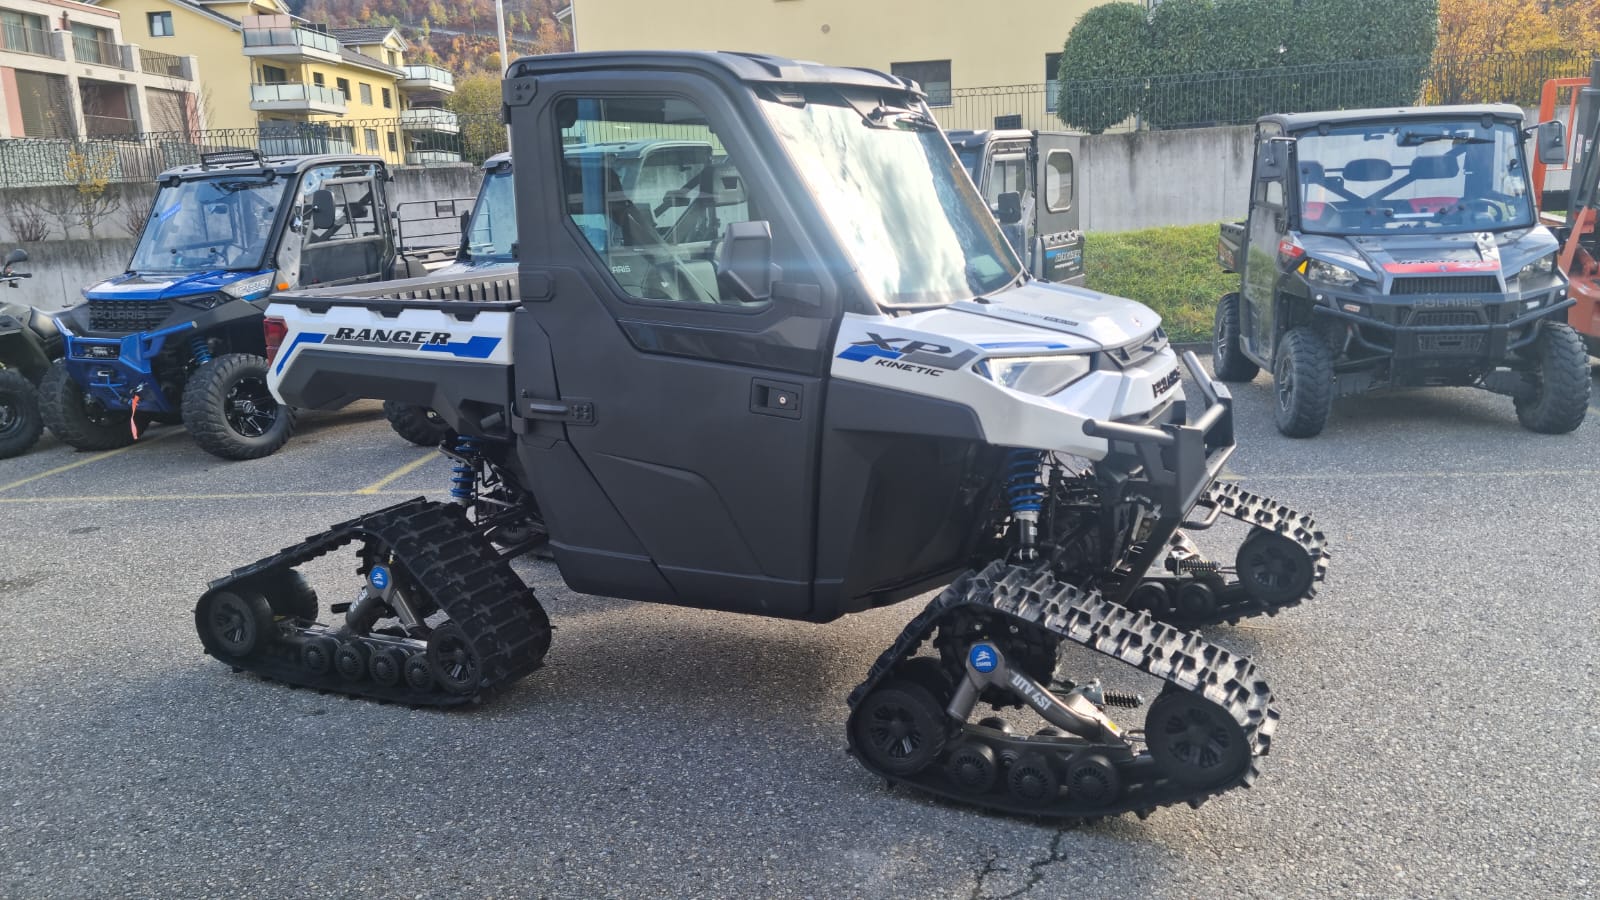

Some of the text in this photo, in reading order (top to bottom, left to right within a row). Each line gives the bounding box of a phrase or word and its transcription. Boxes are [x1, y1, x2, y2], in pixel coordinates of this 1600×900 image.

[95, 309, 146, 320] POLARIS
[334, 327, 451, 345] RANGER
[850, 331, 953, 355] XP
[875, 359, 945, 377] KINETIC
[1012, 674, 1034, 695] UTV
